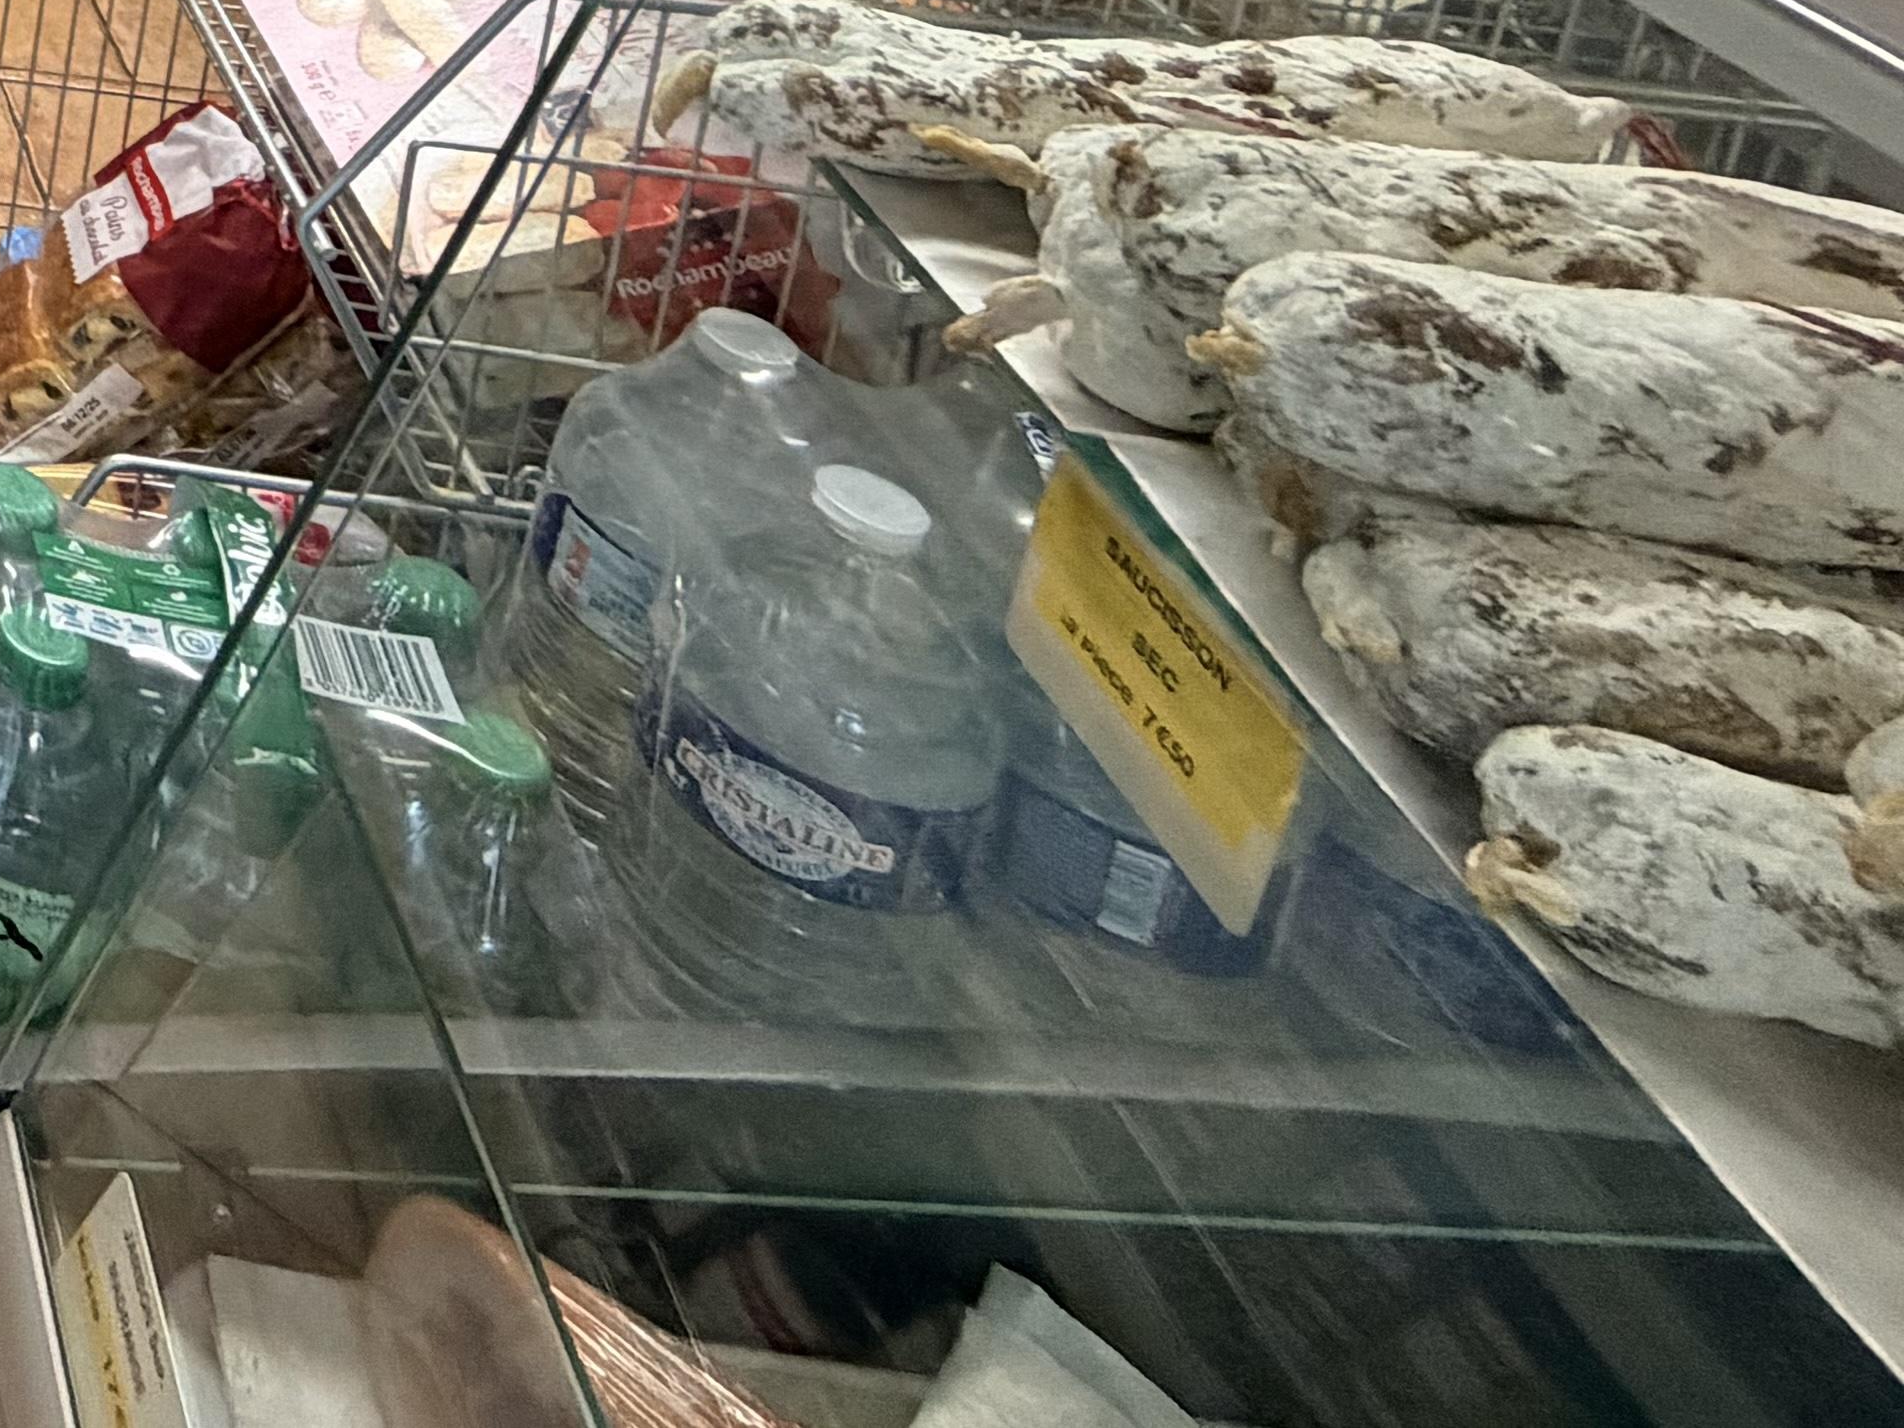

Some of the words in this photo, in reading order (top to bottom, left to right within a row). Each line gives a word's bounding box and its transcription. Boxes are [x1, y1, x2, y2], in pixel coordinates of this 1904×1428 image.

[616, 246, 794, 301] Rochambeau
[1104, 535, 1234, 693] SAUCISSON
[1131, 630, 1181, 695] SEC
[1142, 704, 1196, 779] 7€50
